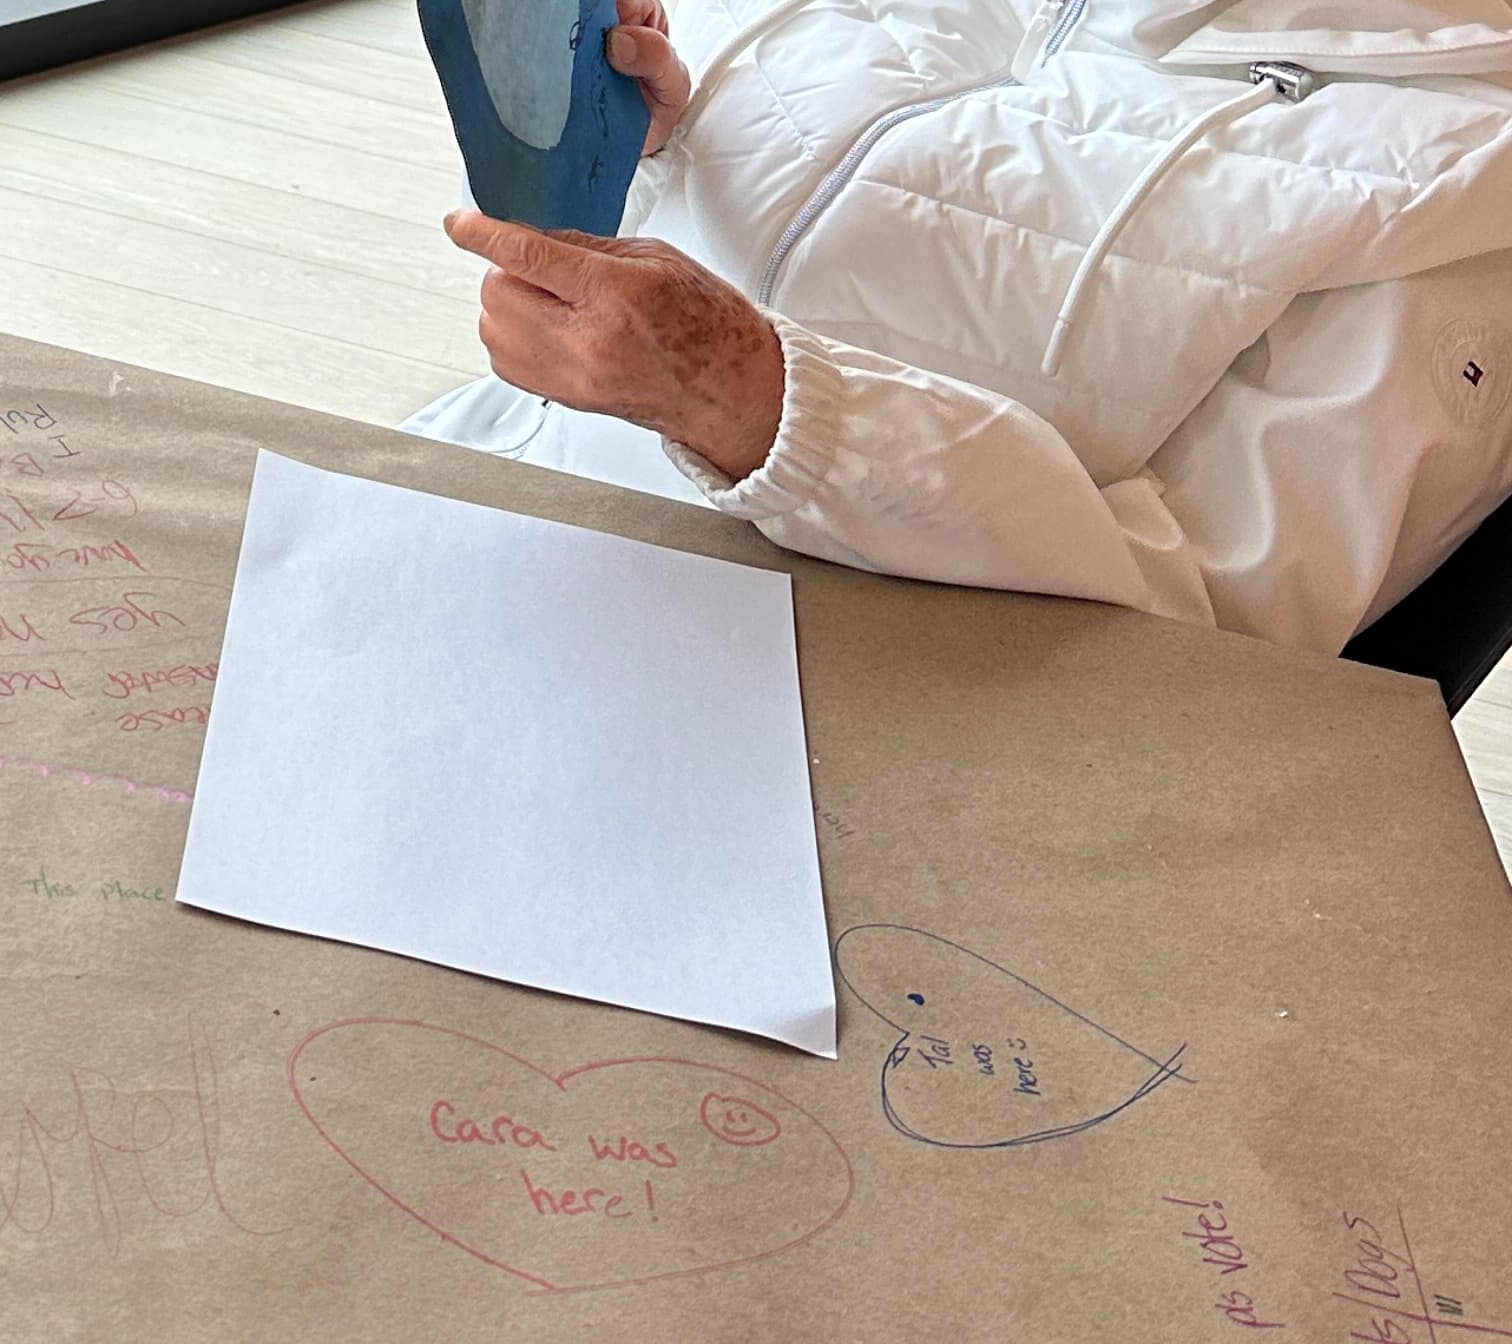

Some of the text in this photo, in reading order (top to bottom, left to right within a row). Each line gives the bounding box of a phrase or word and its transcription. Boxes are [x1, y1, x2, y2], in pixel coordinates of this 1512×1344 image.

[67, 591, 186, 639] yes
[429, 1099, 679, 1169] Cara was
[518, 1167, 661, 1223] here!
[1161, 1195, 1251, 1276] vote!
